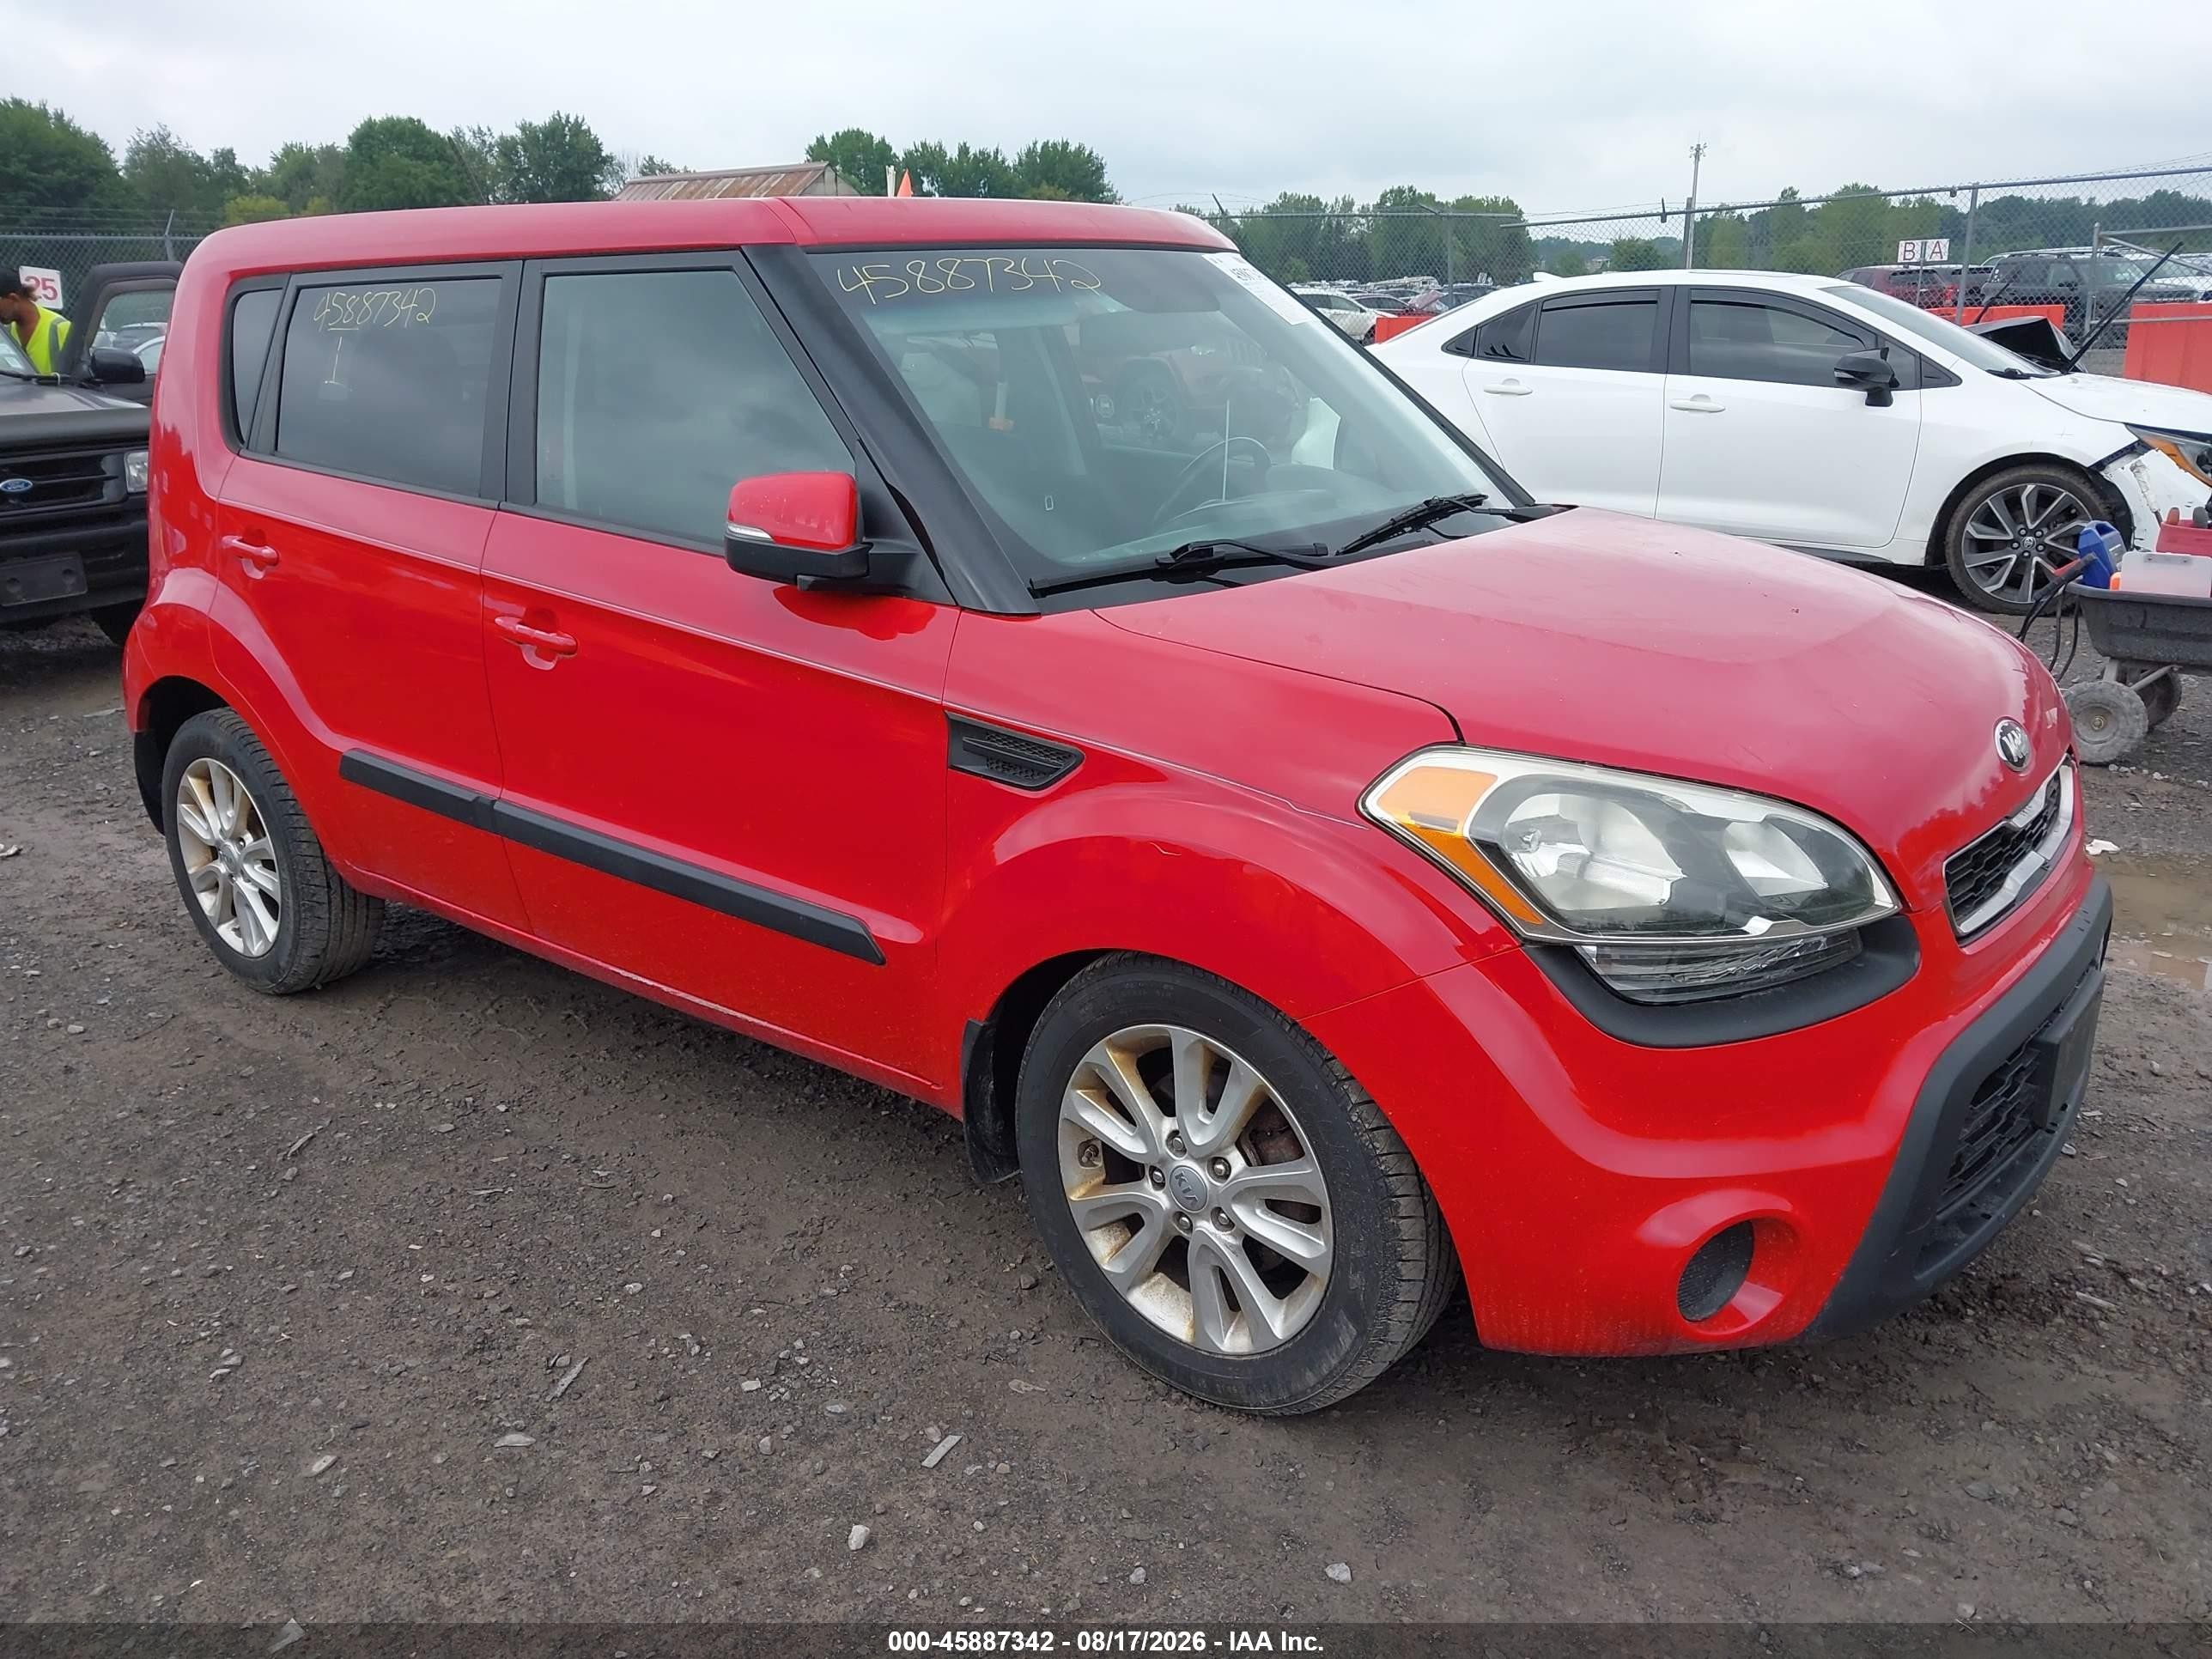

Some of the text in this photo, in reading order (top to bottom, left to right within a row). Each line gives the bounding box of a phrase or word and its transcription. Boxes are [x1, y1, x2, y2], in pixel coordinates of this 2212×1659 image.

[1903, 240, 1943, 261] B A
[837, 258, 1101, 304] 45887342
[313, 288, 436, 331] 45887342
